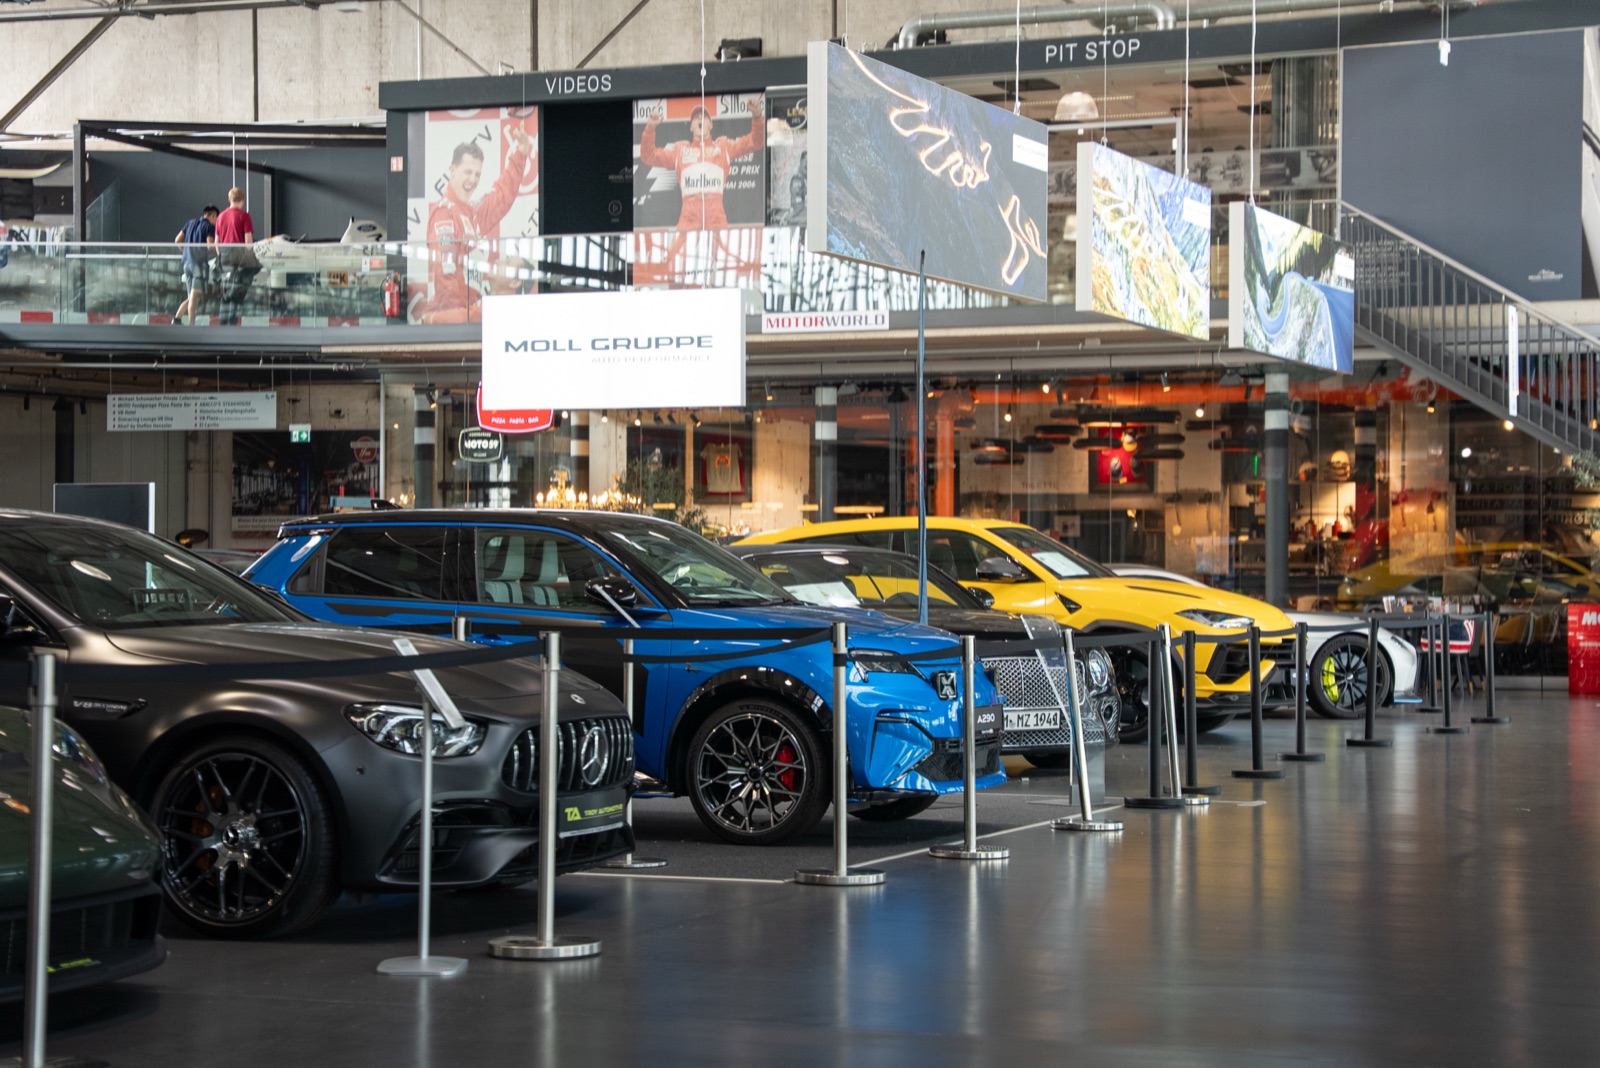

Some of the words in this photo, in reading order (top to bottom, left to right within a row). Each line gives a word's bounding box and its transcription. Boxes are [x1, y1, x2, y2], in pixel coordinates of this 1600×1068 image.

[1045, 42, 1078, 63] PIT
[1084, 39, 1141, 60] STOP
[545, 74, 612, 95] VIDEOS
[740, 164, 761, 176] PRIX
[684, 174, 721, 189] Marlboro
[737, 179, 756, 189] 2006
[766, 313, 885, 330] MOTORWORLD
[504, 338, 582, 353] MOLL
[590, 335, 714, 351] GRUPPE
[491, 416, 506, 424] PIZZA
[977, 713, 995, 724] A290
[1017, 713, 1030, 728] MZ
[564, 806, 582, 821] TA
